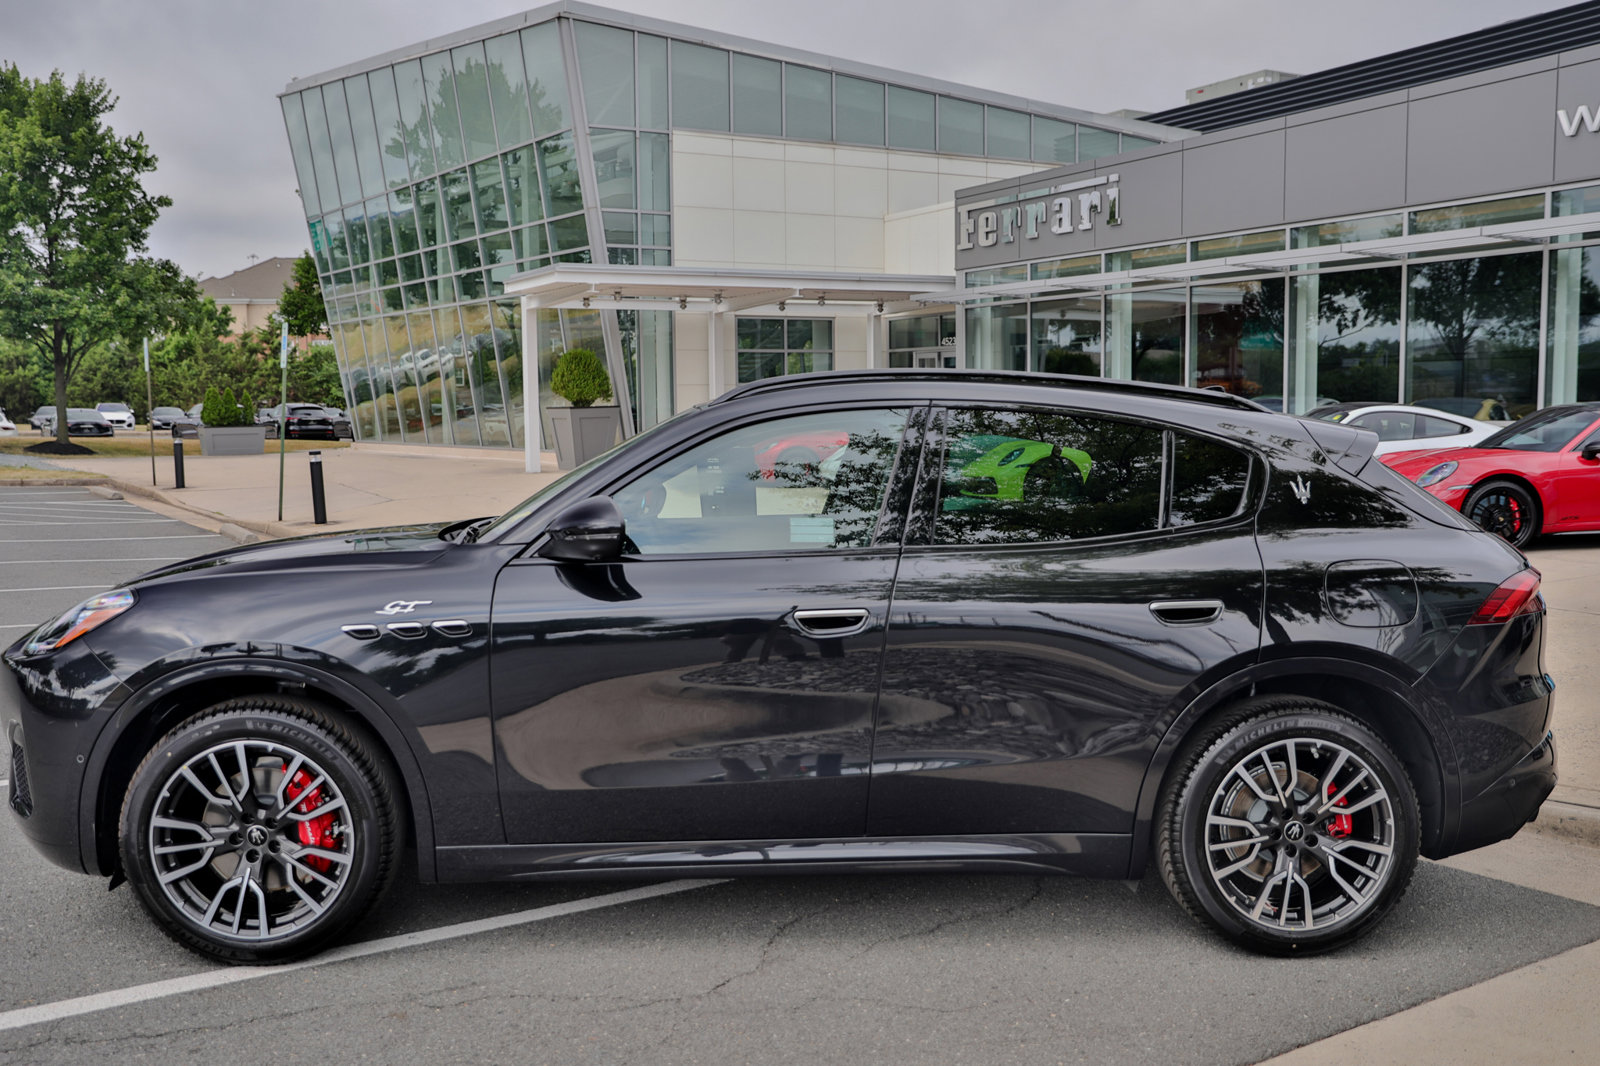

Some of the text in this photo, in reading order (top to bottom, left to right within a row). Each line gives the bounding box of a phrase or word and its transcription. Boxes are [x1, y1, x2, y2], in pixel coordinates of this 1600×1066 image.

[957, 173, 1122, 250] Ferrari
[375, 600, 433, 615] GT
[271, 724, 335, 759] MICHELIN
[1235, 719, 1297, 749] MICHELIN
